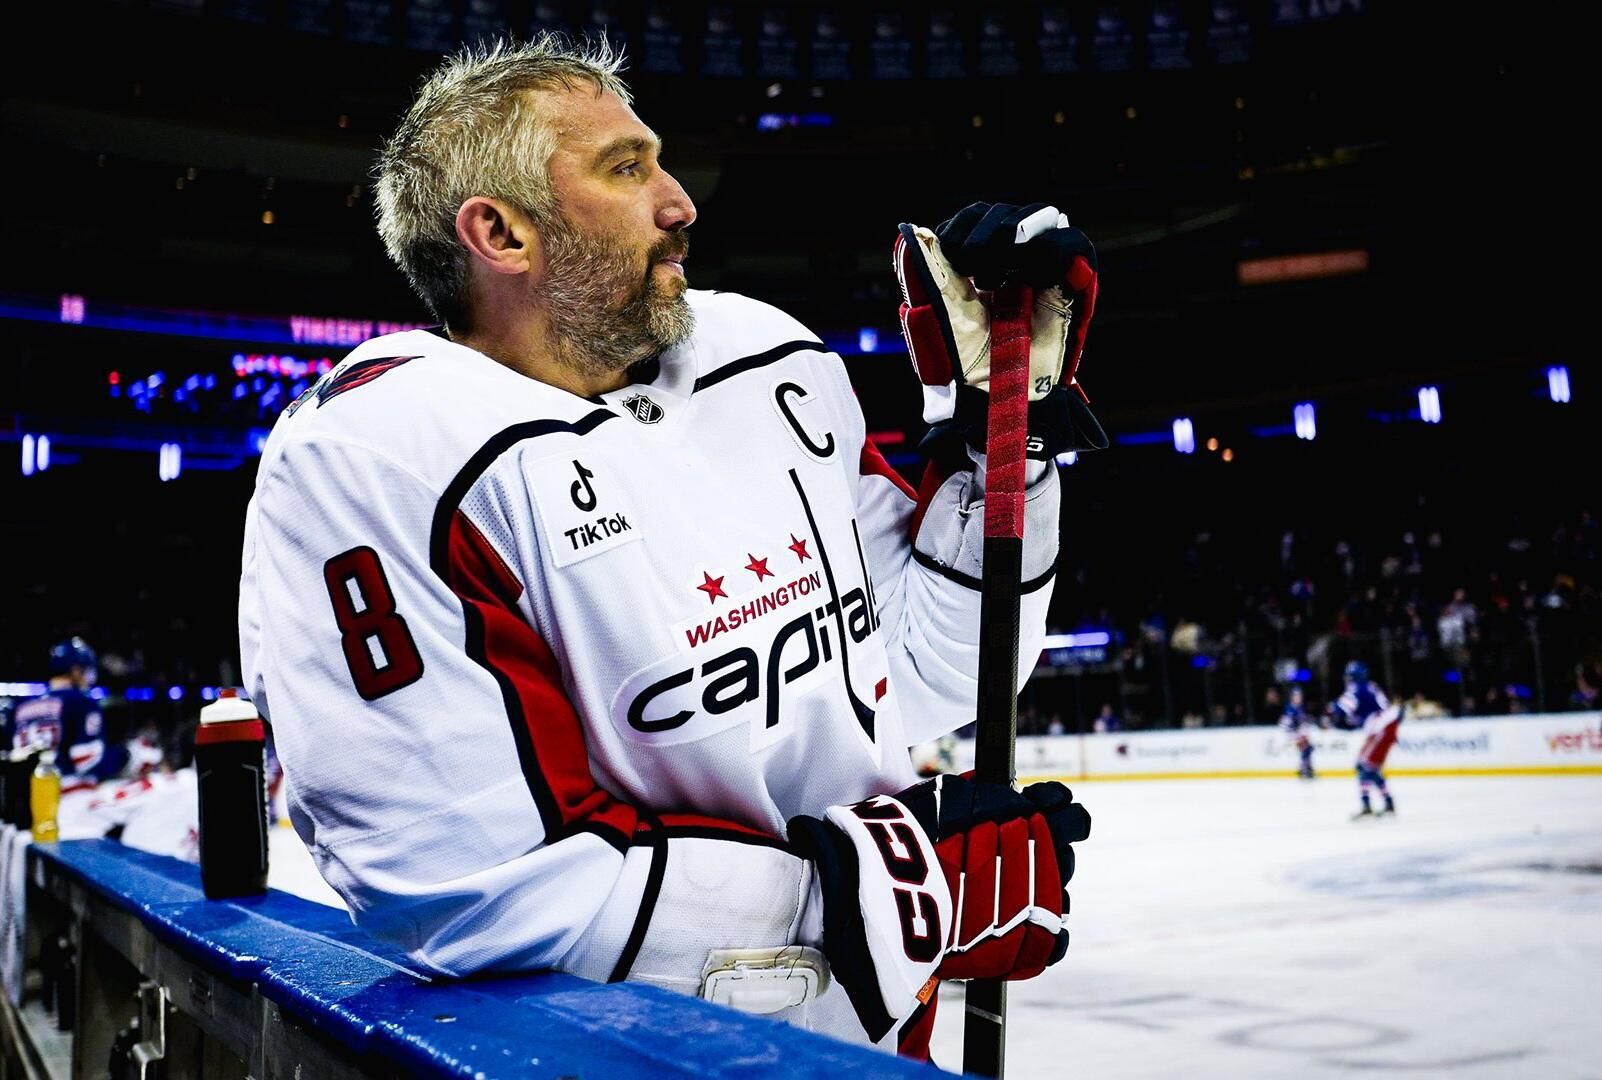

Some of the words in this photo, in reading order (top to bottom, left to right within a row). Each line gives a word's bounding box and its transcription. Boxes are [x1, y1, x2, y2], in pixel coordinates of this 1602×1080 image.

[775, 382, 835, 458] C
[564, 513, 632, 551] TikTok
[323, 545, 425, 701] 8
[685, 571, 822, 648] WASHINGTON
